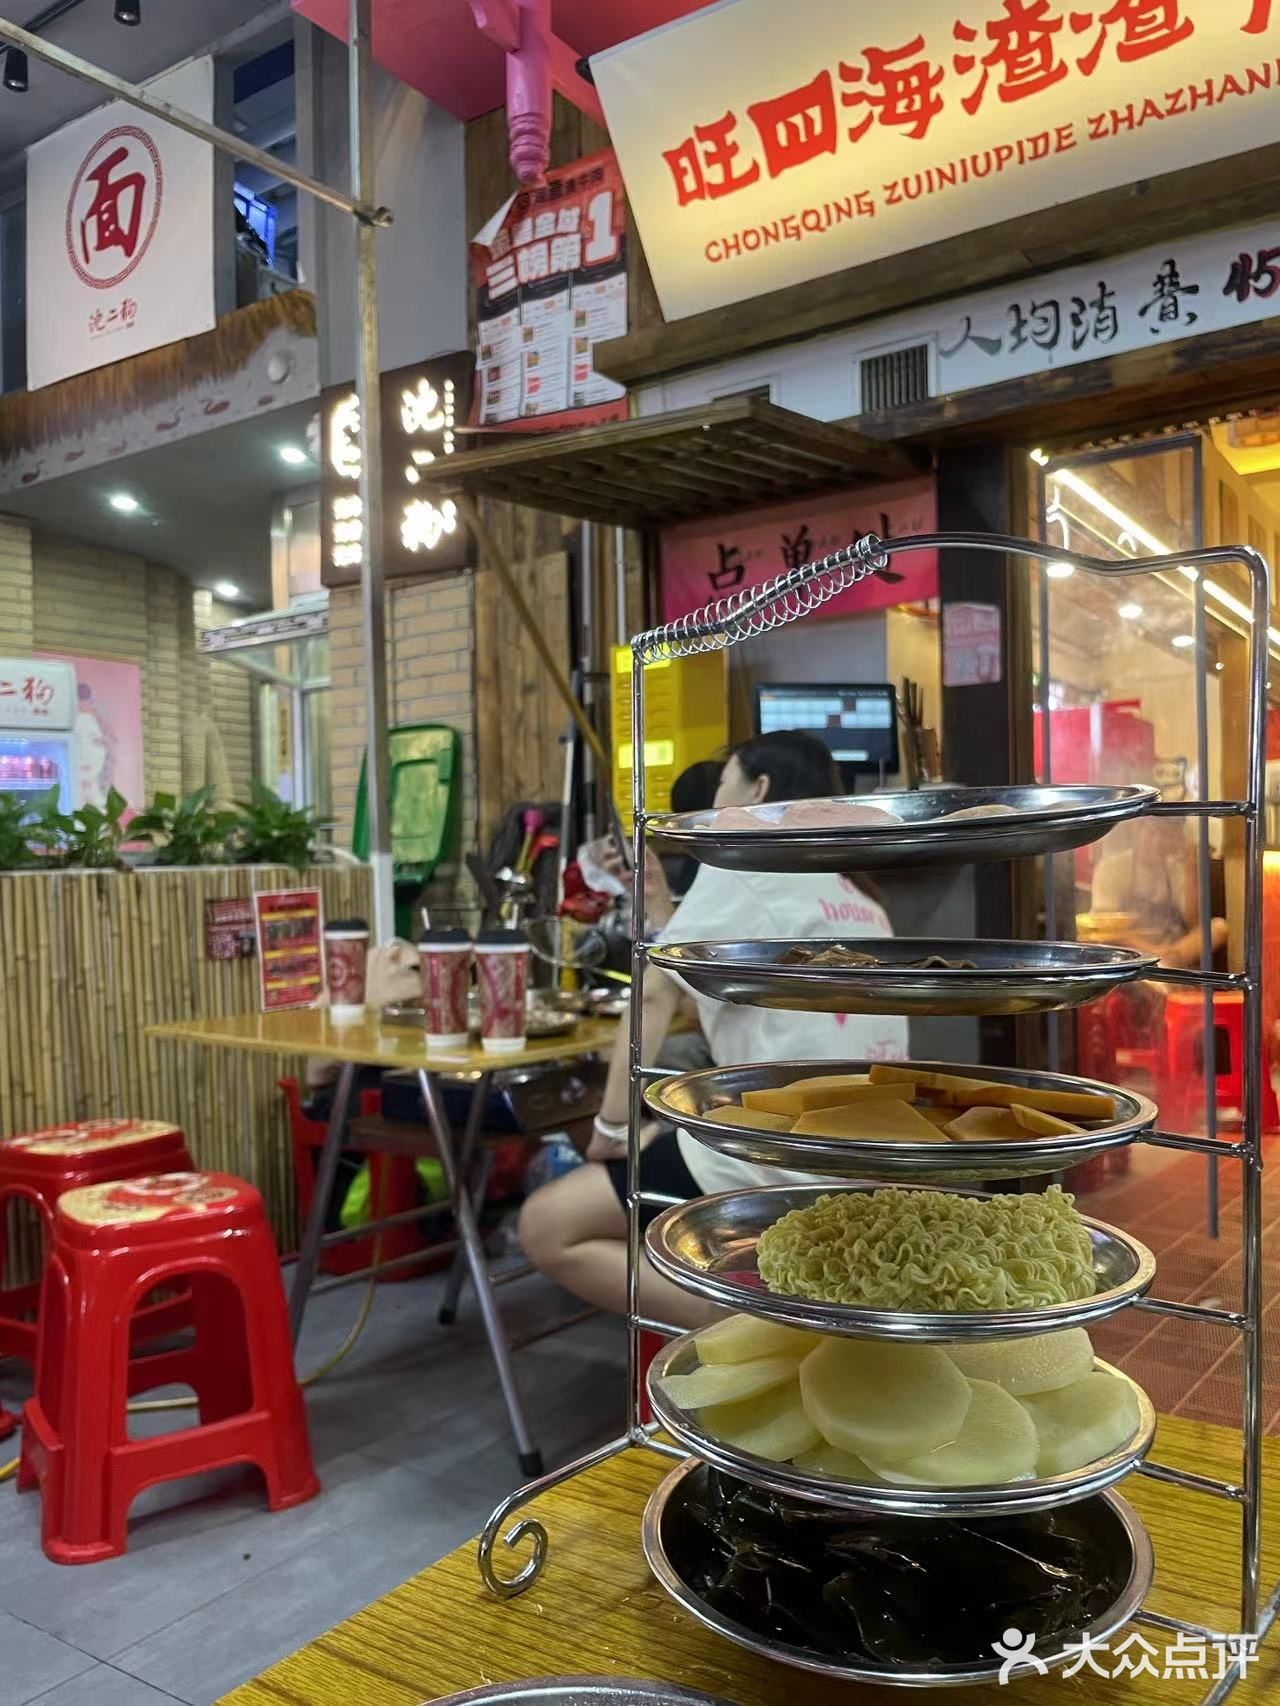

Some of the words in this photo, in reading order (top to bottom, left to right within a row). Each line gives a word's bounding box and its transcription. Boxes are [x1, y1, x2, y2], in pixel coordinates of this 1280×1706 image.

[662, 0, 1272, 206] 旺四海渣渣
[80, 146, 145, 264] 面
[704, 190, 876, 262] CHONGQING
[883, 123, 1077, 207] ZUINIUPIDE
